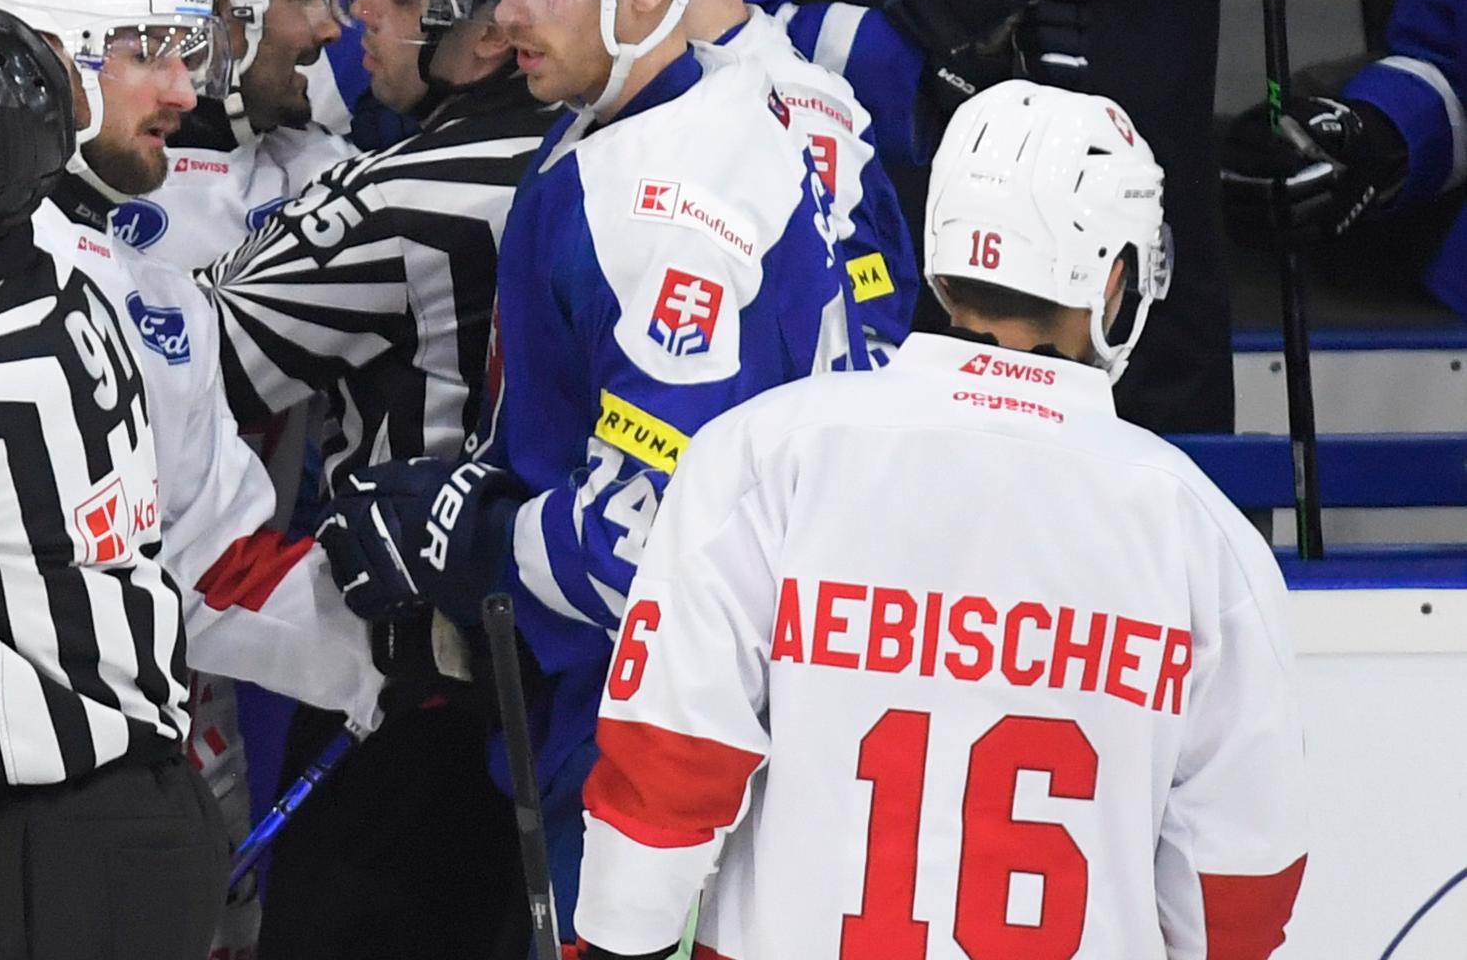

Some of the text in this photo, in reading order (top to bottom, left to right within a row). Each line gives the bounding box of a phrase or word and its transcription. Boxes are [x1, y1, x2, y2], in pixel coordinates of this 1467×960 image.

[780, 91, 854, 133] aufland
[189, 160, 230, 174] SWISS
[680, 199, 755, 257] Kaufland
[968, 229, 1002, 270] 16
[64, 283, 134, 412] 91
[991, 359, 1057, 386] SWISS
[600, 406, 680, 464] RTUNA
[769, 578, 1193, 716] AEBISCHER
[838, 708, 1099, 960] 16
